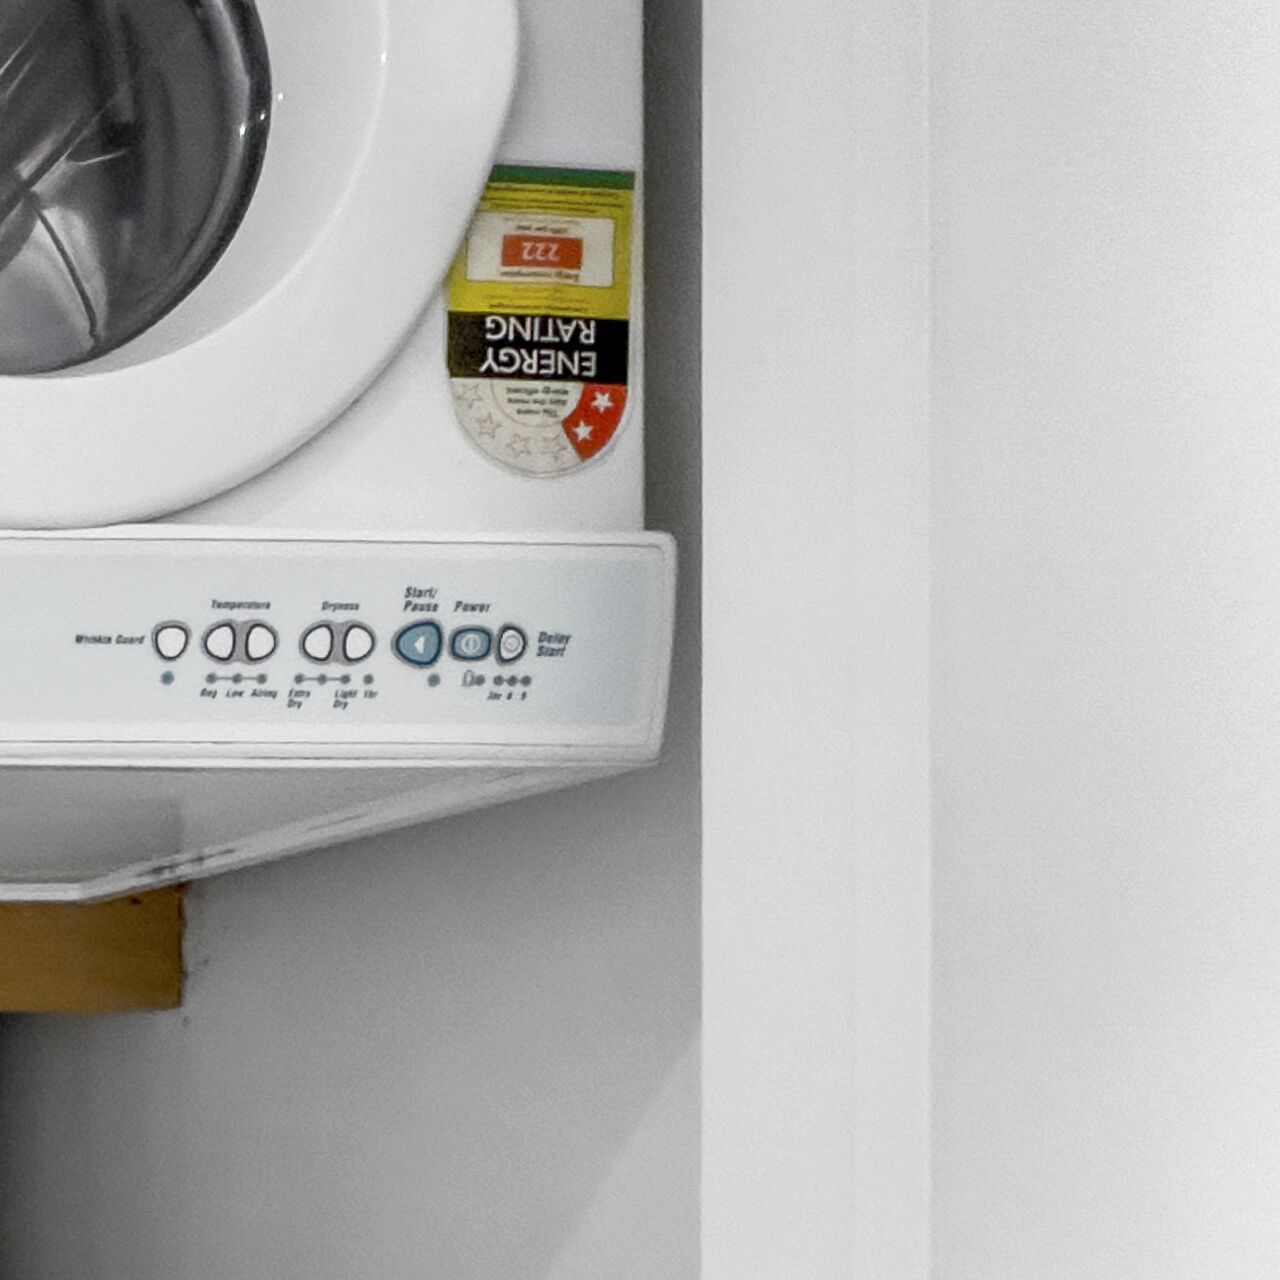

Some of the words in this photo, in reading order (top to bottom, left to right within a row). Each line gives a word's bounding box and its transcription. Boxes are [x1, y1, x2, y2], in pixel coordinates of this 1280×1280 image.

[520, 241, 561, 262] 222
[484, 316, 596, 344] RATING
[479, 347, 597, 377] ENERGY
[404, 587, 438, 599] Start/
[210, 599, 272, 610] Temperature
[403, 601, 439, 613] Pause
[454, 601, 492, 613] Power
[538, 632, 572, 646] Delay
[536, 645, 567, 657] Start
